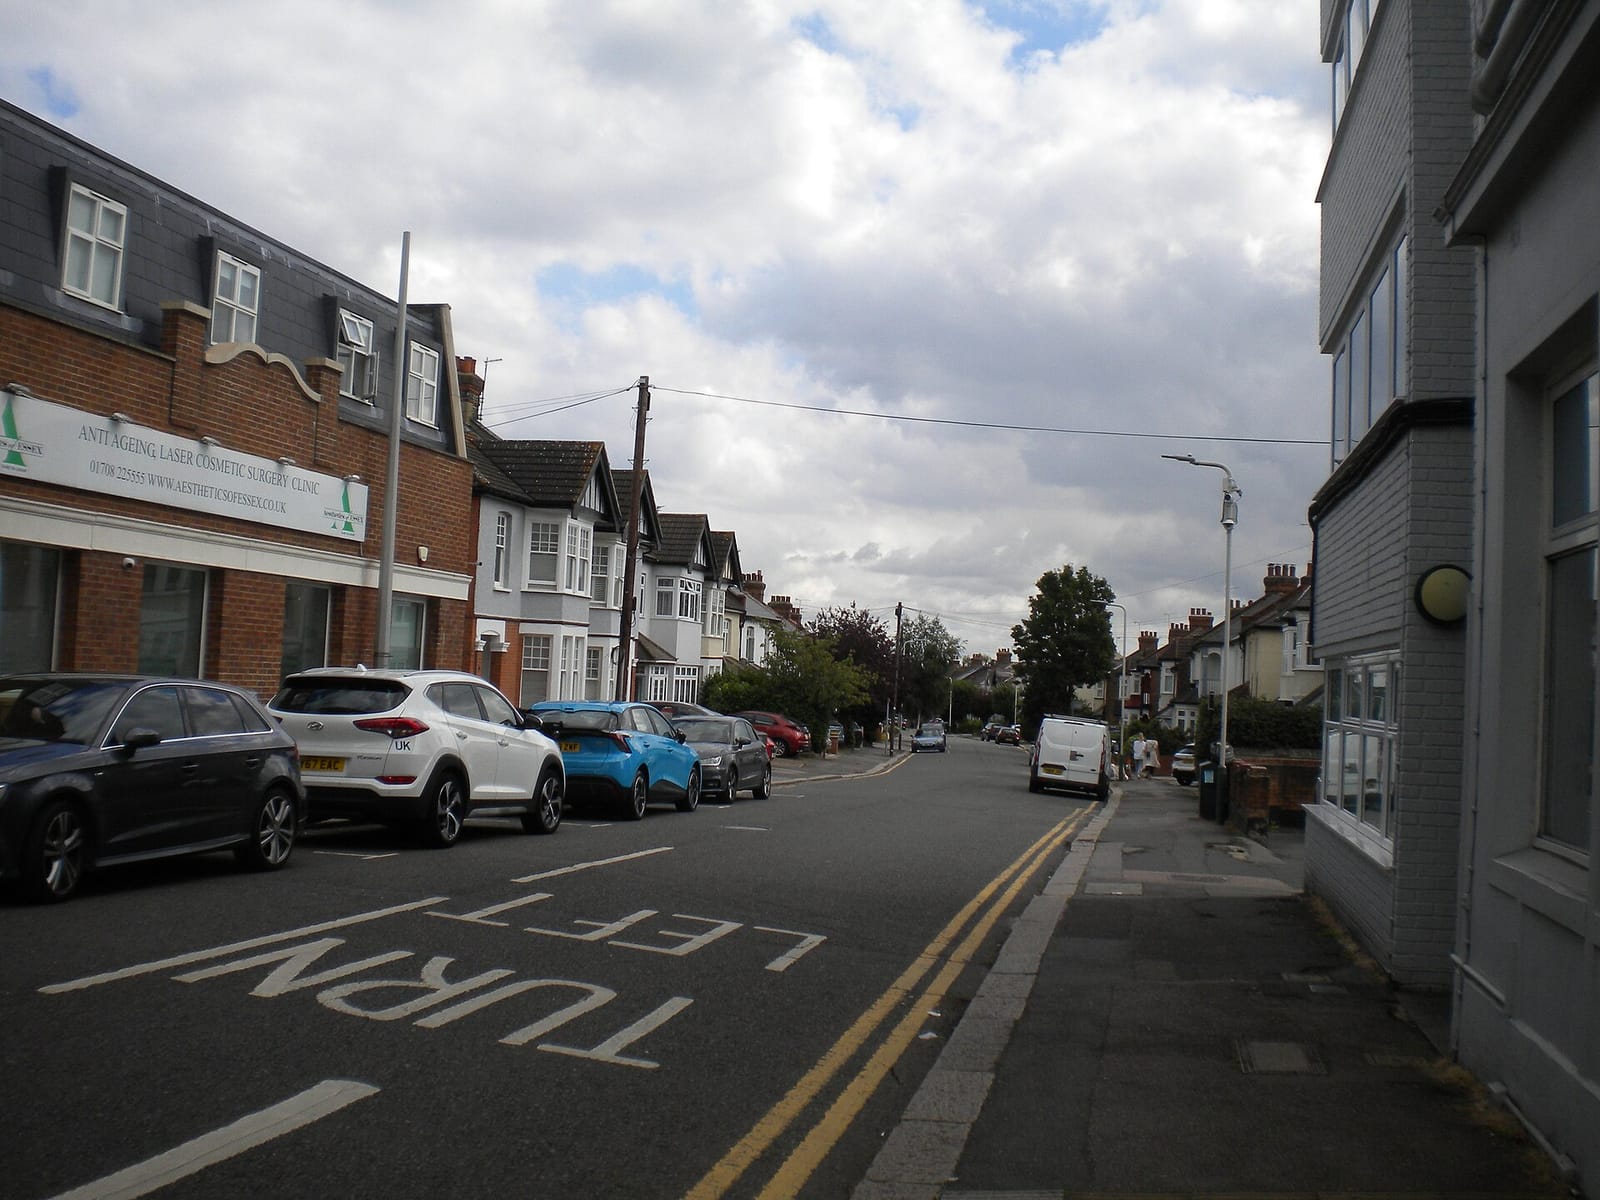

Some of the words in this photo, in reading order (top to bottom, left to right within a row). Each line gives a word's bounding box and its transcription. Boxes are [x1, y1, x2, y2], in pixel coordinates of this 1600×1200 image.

[79, 425, 110, 446] ANTI
[160, 445, 194, 466] LASER
[195, 453, 246, 478] COSMETIC
[247, 465, 288, 488] SURGERY
[291, 476, 320, 495] CLINIC
[90, 459, 115, 478] 01708
[395, 741, 411, 751] UK
[423, 893, 827, 972] LEFT
[169, 937, 694, 1069] TURN
